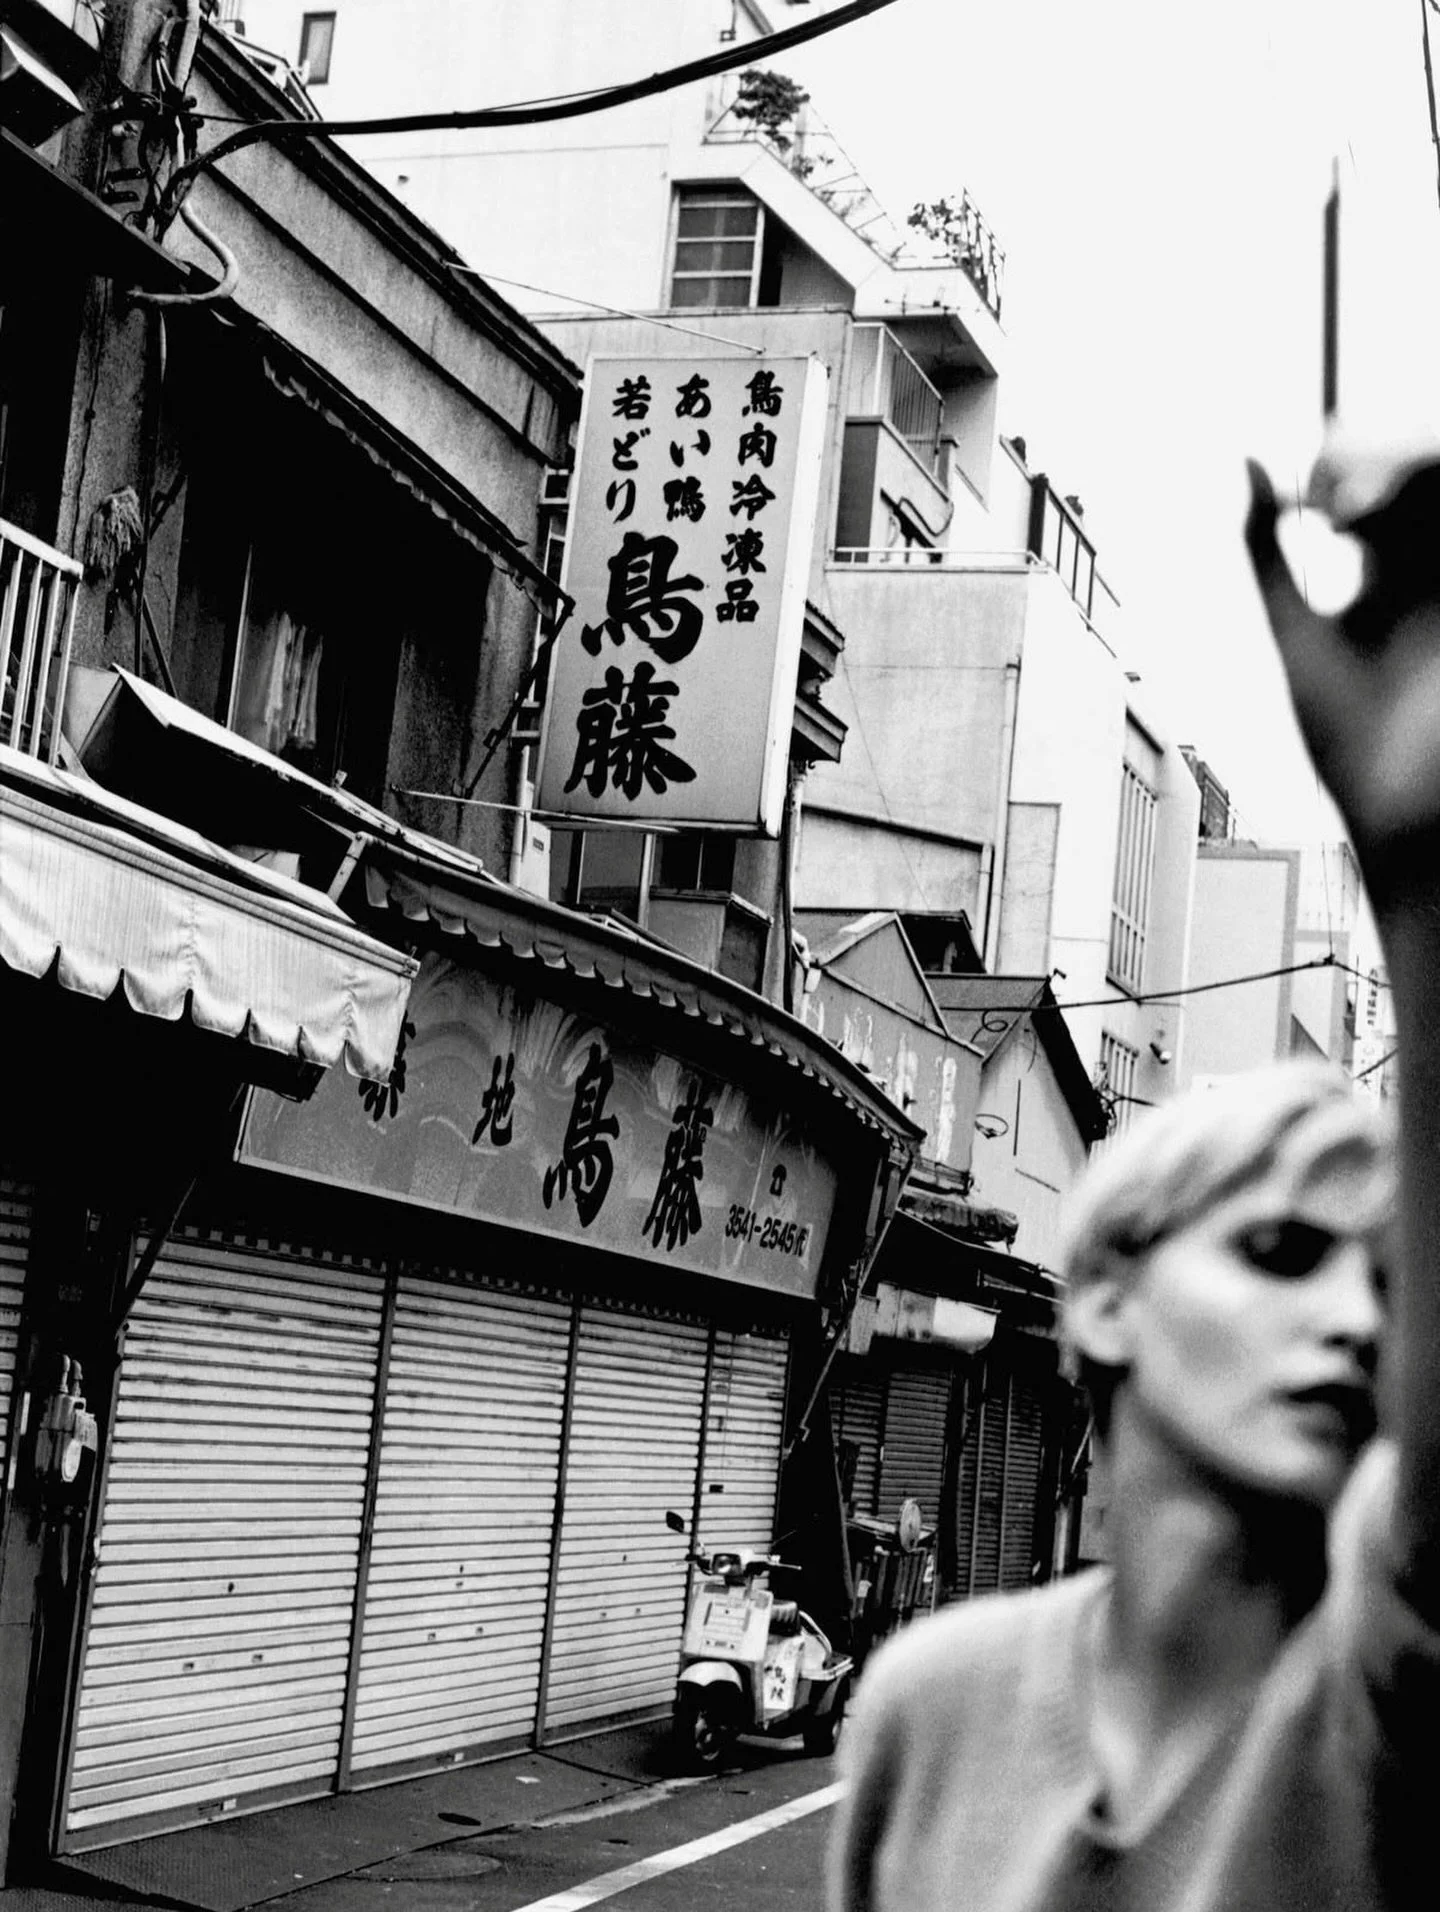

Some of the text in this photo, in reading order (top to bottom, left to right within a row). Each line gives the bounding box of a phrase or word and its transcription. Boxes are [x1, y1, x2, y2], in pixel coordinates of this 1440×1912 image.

[606, 375, 652, 523] 若どり
[663, 373, 711, 521] あい鴨
[716, 370, 784, 624] 鳥肉冷凍品
[563, 531, 704, 800] 鳥藤
